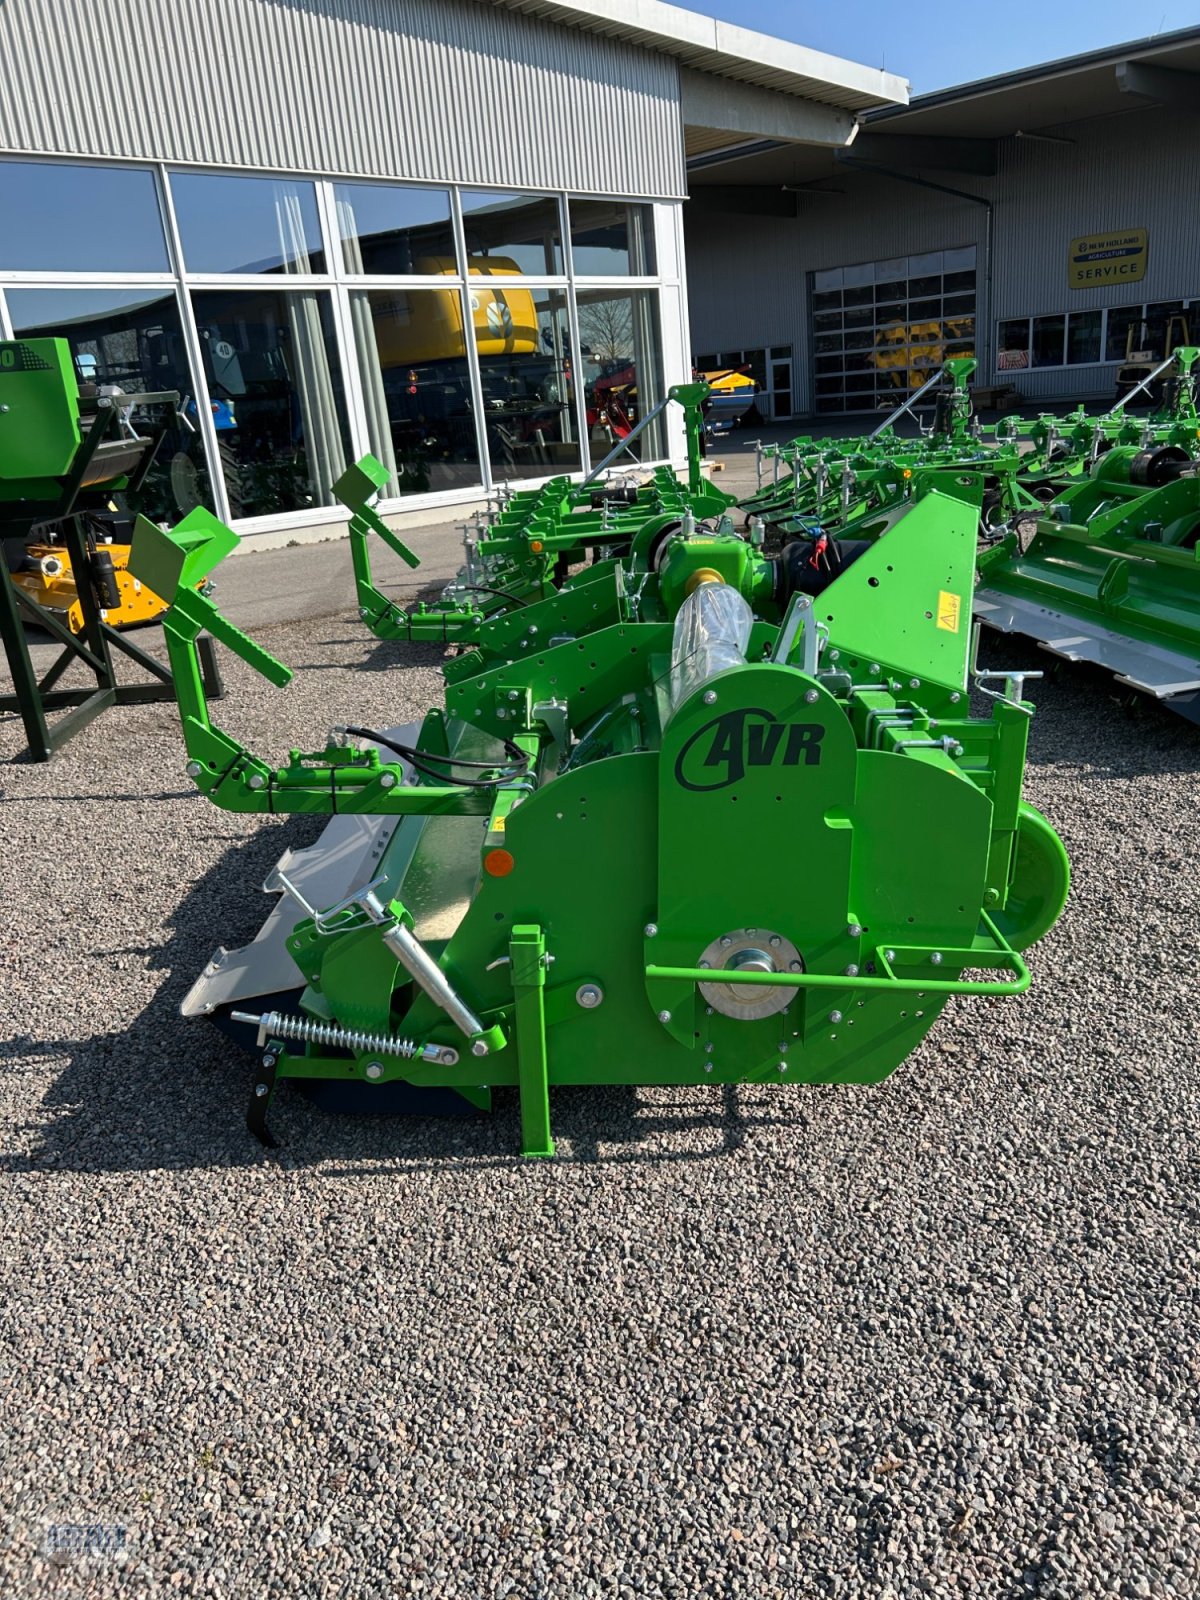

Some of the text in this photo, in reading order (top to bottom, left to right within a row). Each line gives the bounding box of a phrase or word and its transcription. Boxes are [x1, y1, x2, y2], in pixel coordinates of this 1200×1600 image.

[1088, 236, 1139, 250] NEW HOLLAND
[1087, 249, 1127, 260] AGRICULTURE
[1077, 263, 1138, 280] SERVICE
[219, 344, 230, 356] 40
[0, 349, 15, 368] 0
[684, 708, 826, 786] AVR
